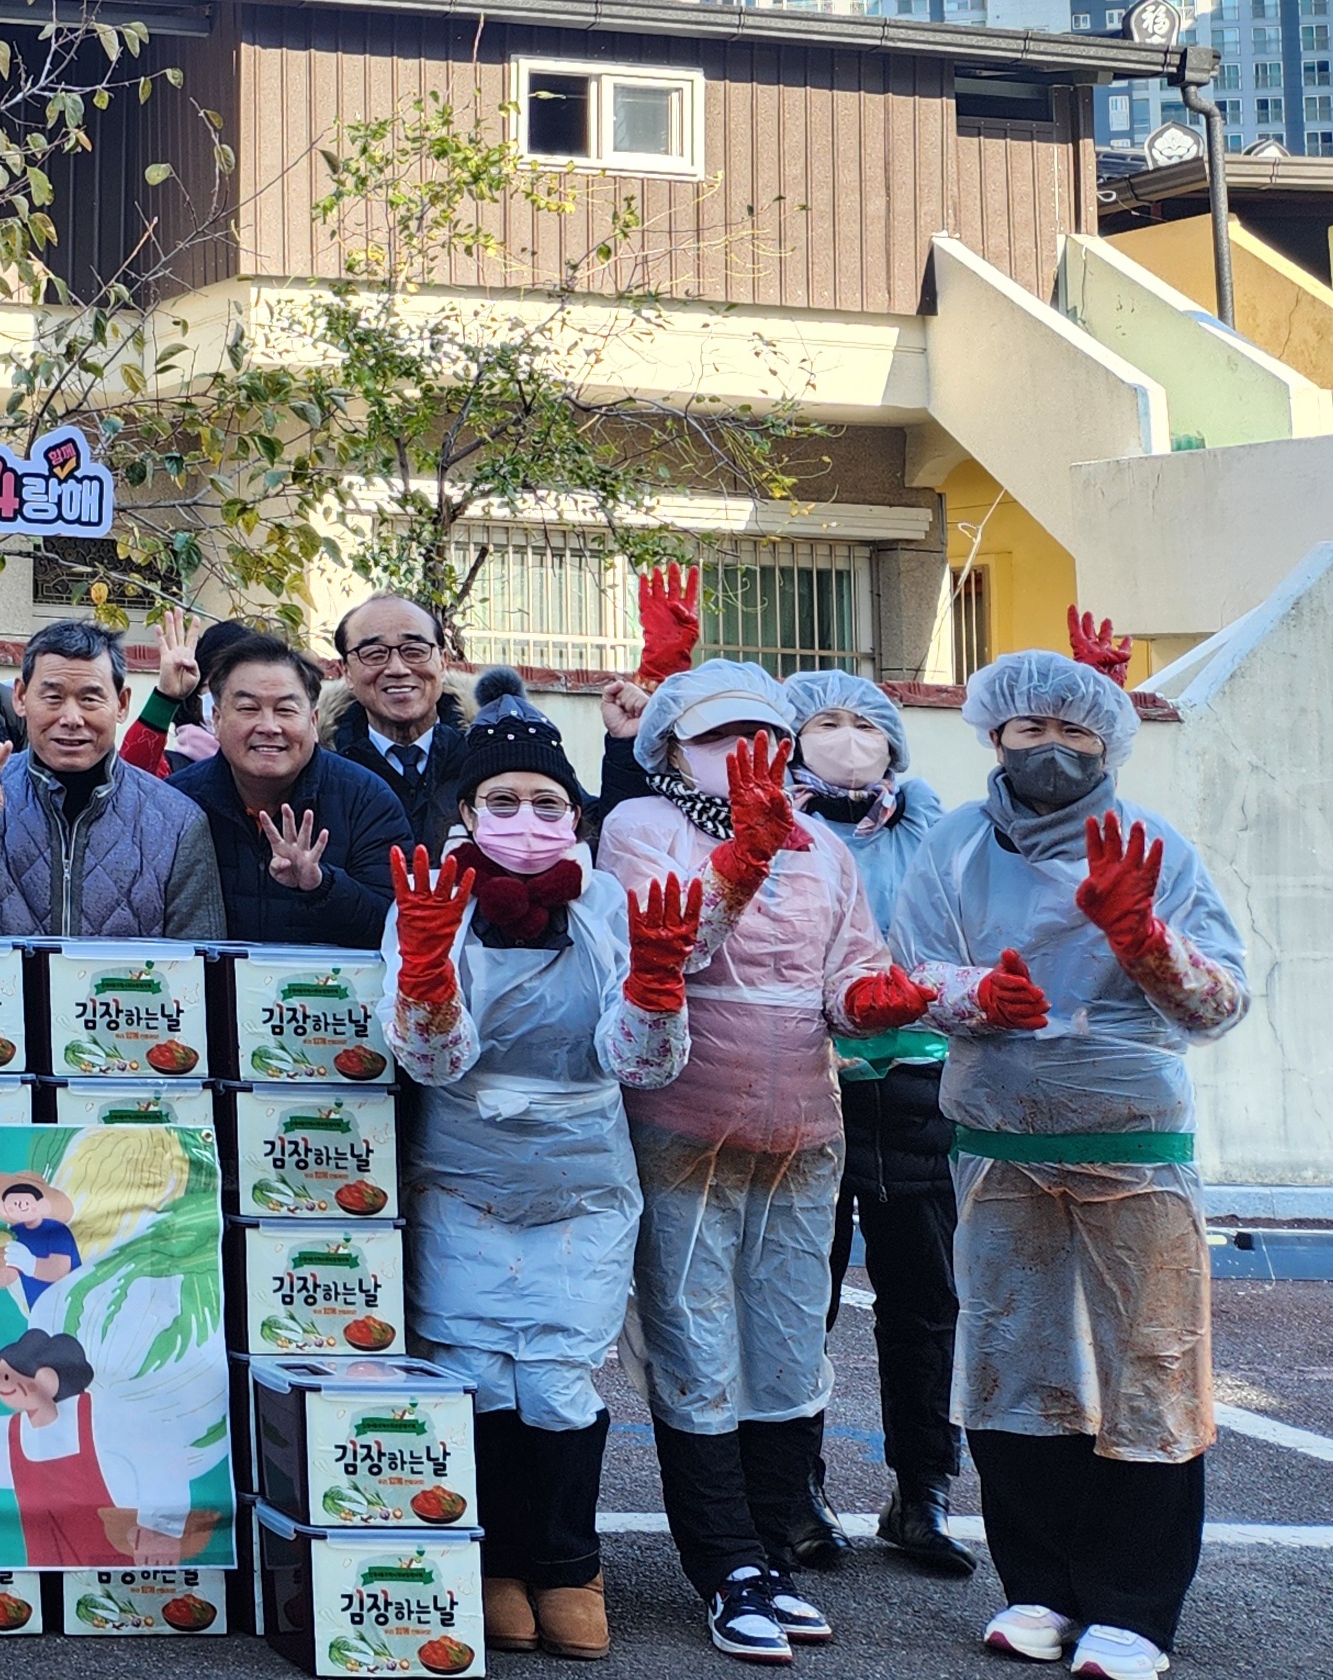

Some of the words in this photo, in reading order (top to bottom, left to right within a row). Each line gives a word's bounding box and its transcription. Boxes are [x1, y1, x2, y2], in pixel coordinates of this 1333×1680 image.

[75, 999, 184, 1033] 김장하는날
[262, 1003, 372, 1038] 김장하는날
[264, 1136, 374, 1172] 김장하는날
[272, 1272, 382, 1308] 김장하는날
[334, 1440, 451, 1477] 김장하는날
[341, 1588, 459, 1628] 김장하는날
